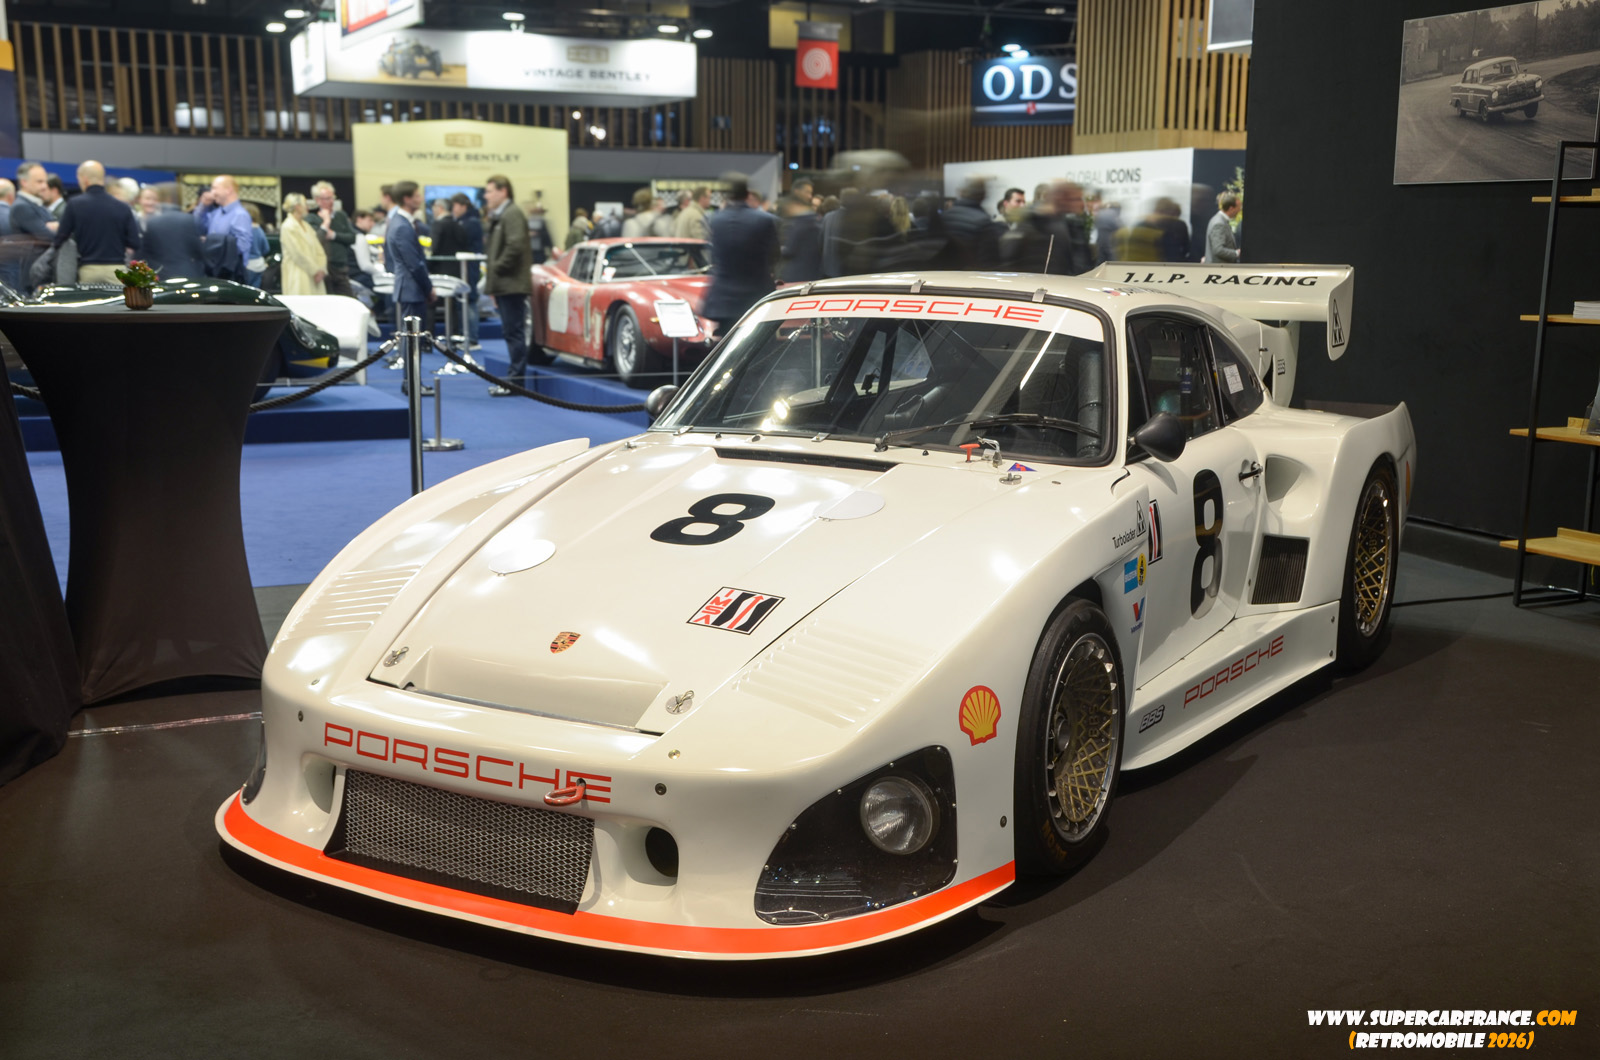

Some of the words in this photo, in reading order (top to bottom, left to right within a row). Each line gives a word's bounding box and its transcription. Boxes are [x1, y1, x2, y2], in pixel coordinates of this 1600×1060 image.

[522, 68, 584, 79] VINTAGE
[588, 69, 652, 81] BENTLEY
[406, 151, 460, 161] VINTAGE
[465, 153, 520, 162] BENTLEY
[1105, 168, 1142, 184] ICONS
[1123, 272, 1190, 284] J.L.P.
[1203, 274, 1317, 286] RACING
[786, 298, 1045, 323] PORSCHE
[650, 493, 776, 546] 8
[1112, 527, 1136, 549] Turbolader
[1190, 469, 1223, 620] 8
[693, 589, 735, 625] IMSA
[1183, 635, 1284, 708] PORSCHE
[1138, 704, 1166, 734] BBS
[324, 722, 612, 804] PORSCHE
